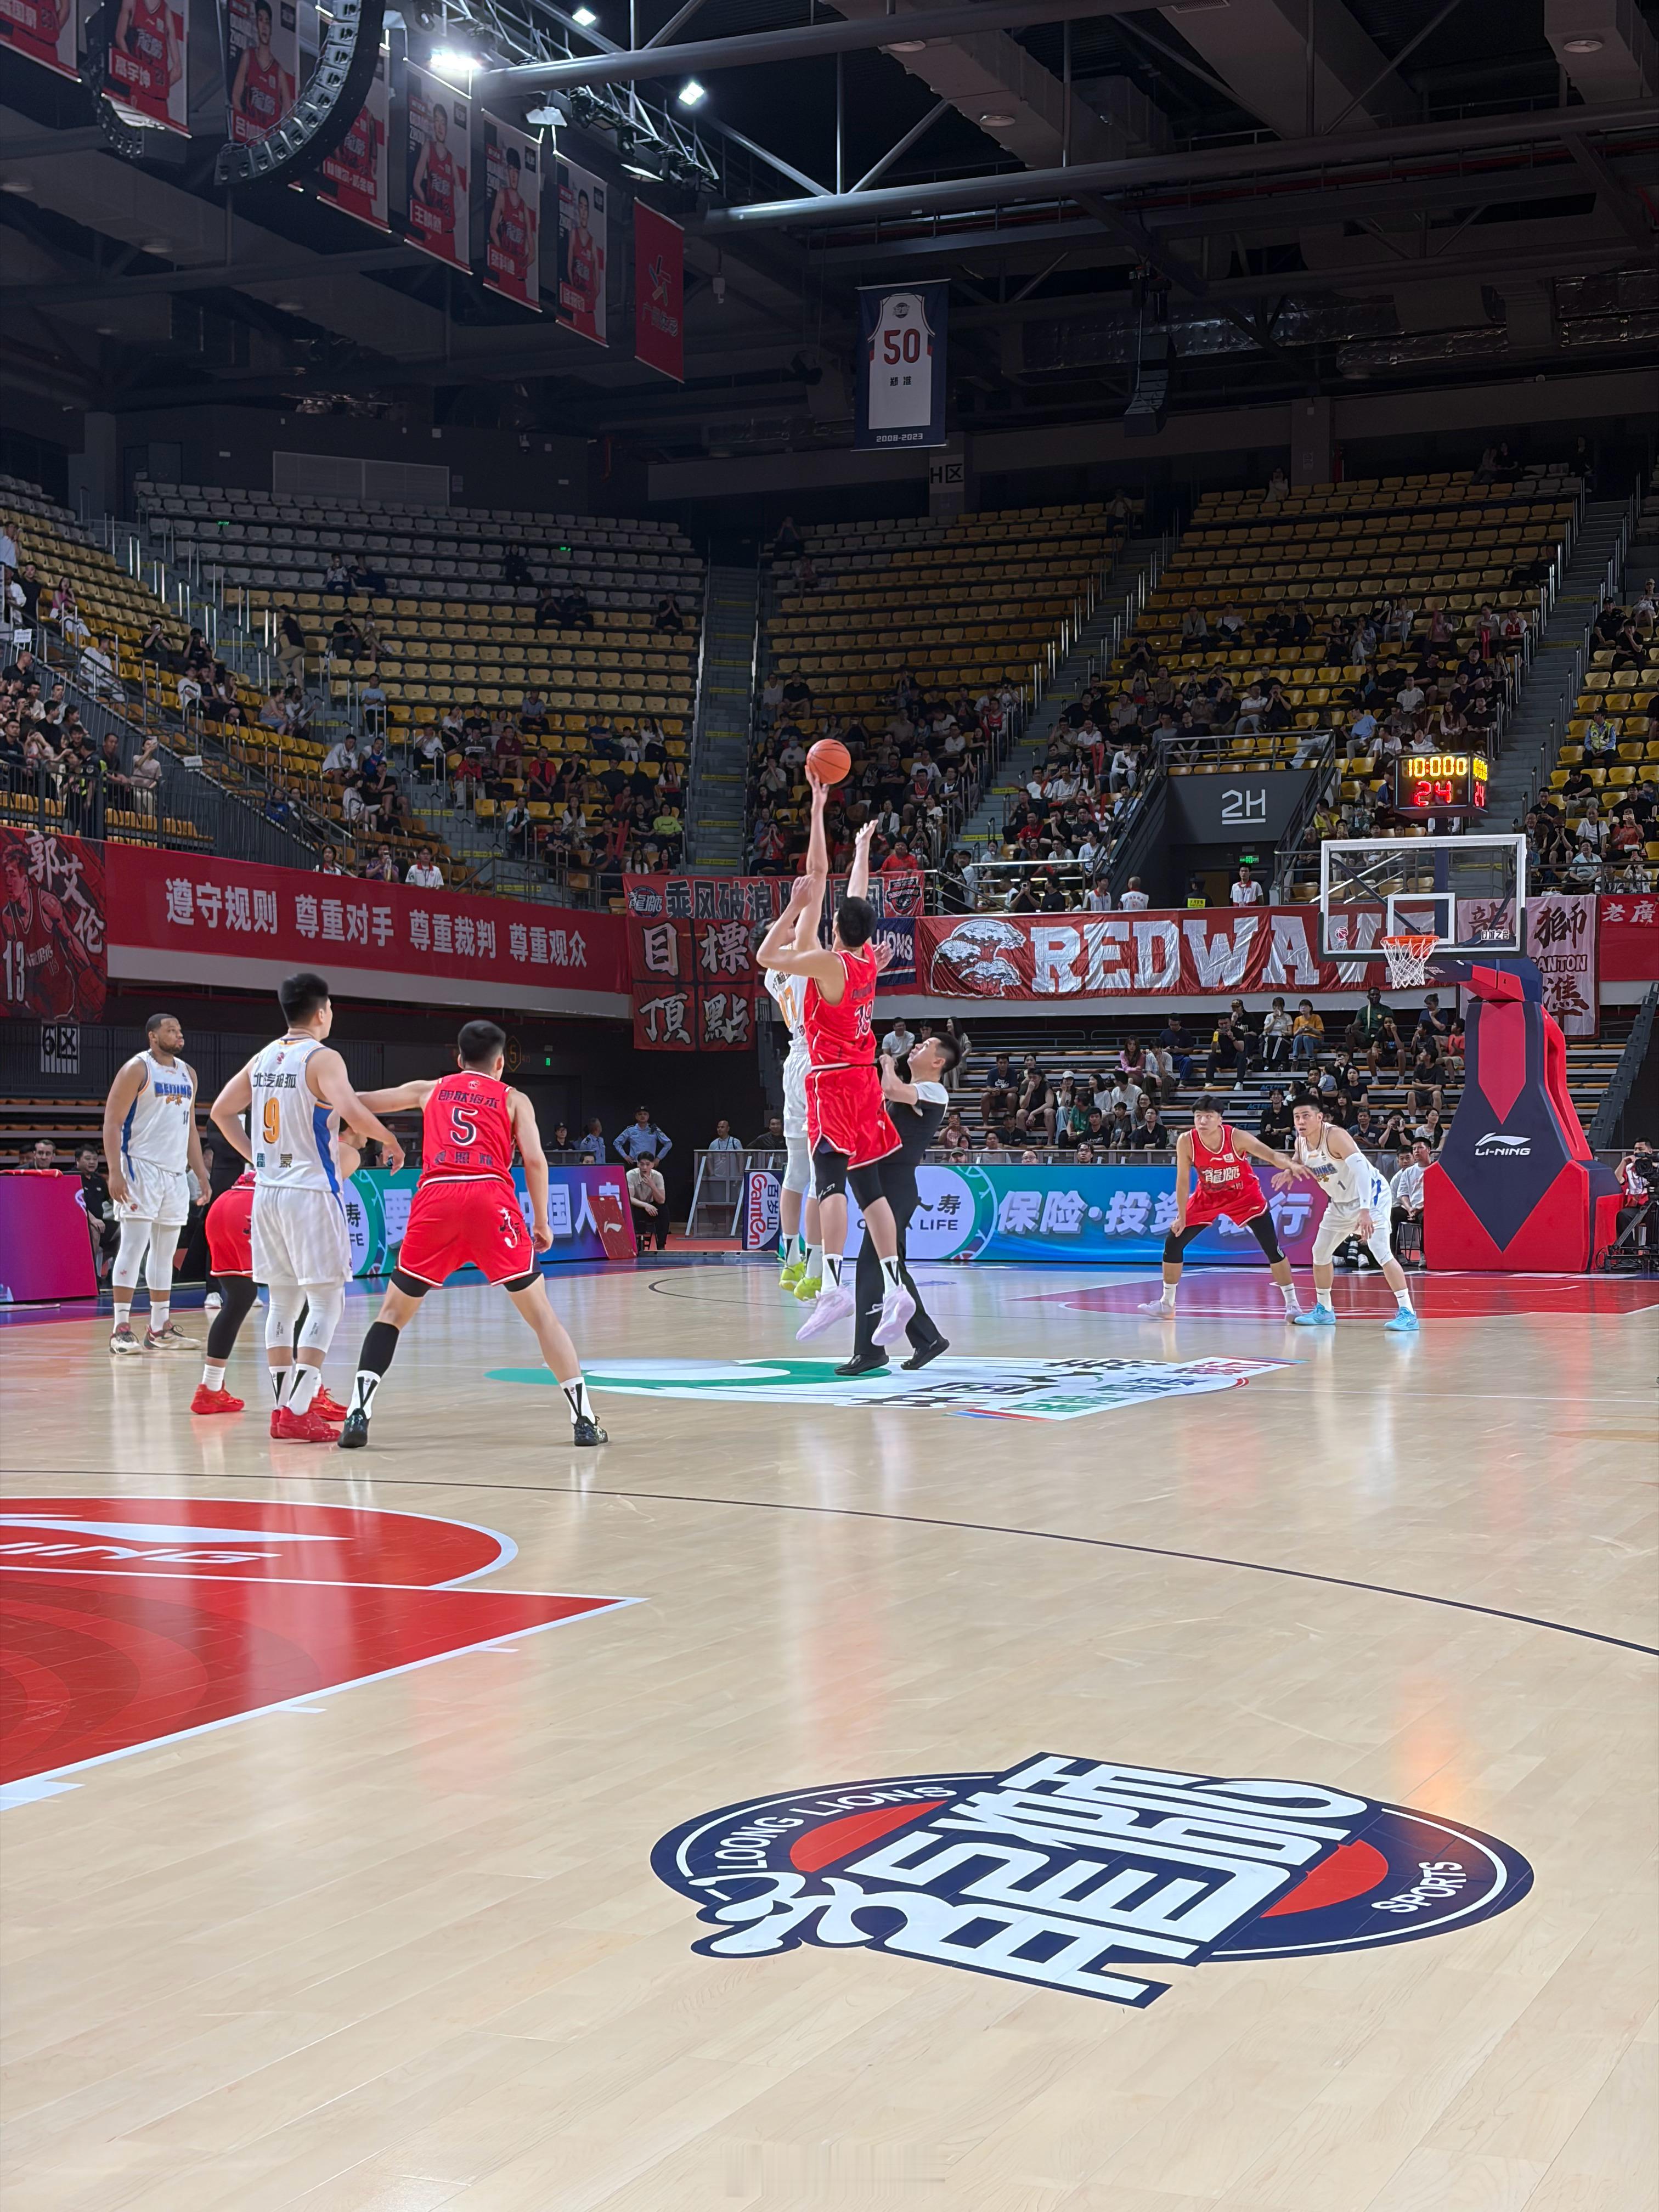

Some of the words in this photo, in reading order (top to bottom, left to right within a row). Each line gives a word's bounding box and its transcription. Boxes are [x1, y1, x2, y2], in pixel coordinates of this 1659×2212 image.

[883, 328, 921, 365] 50
[876, 432, 924, 443] 2008-2023
[930, 464, 963, 484] H区
[1221, 789, 1266, 818] 2H
[1414, 780, 1453, 807] 24
[24, 833, 105, 953] 郭艾伦
[165, 877, 278, 935] 遵守规则
[295, 893, 394, 947] 尊重对手
[409, 909, 496, 959] 尊重裁判
[509, 923, 588, 968] 尊重观众
[642, 920, 751, 976] 目標
[3, 940, 25, 1002] 13
[640, 992, 751, 1045] 頂點
[42, 1025, 78, 1060] 6区
[252, 1072, 297, 1089] 北汽极狐
[263, 1097, 280, 1144] 9
[450, 1106, 479, 1147] 5
[1474, 1148, 1532, 1156] LI-NING
[1337, 1180, 1346, 1190] 1
[748, 1173, 768, 1245] Ganten
[766, 1184, 780, 1231] 百岁山
[920, 1219, 959, 1231] LIFE
[788, 1786, 956, 1817] LIONS
[714, 1816, 804, 1870] LOONG
[1371, 1861, 1467, 1914] SPORTS
